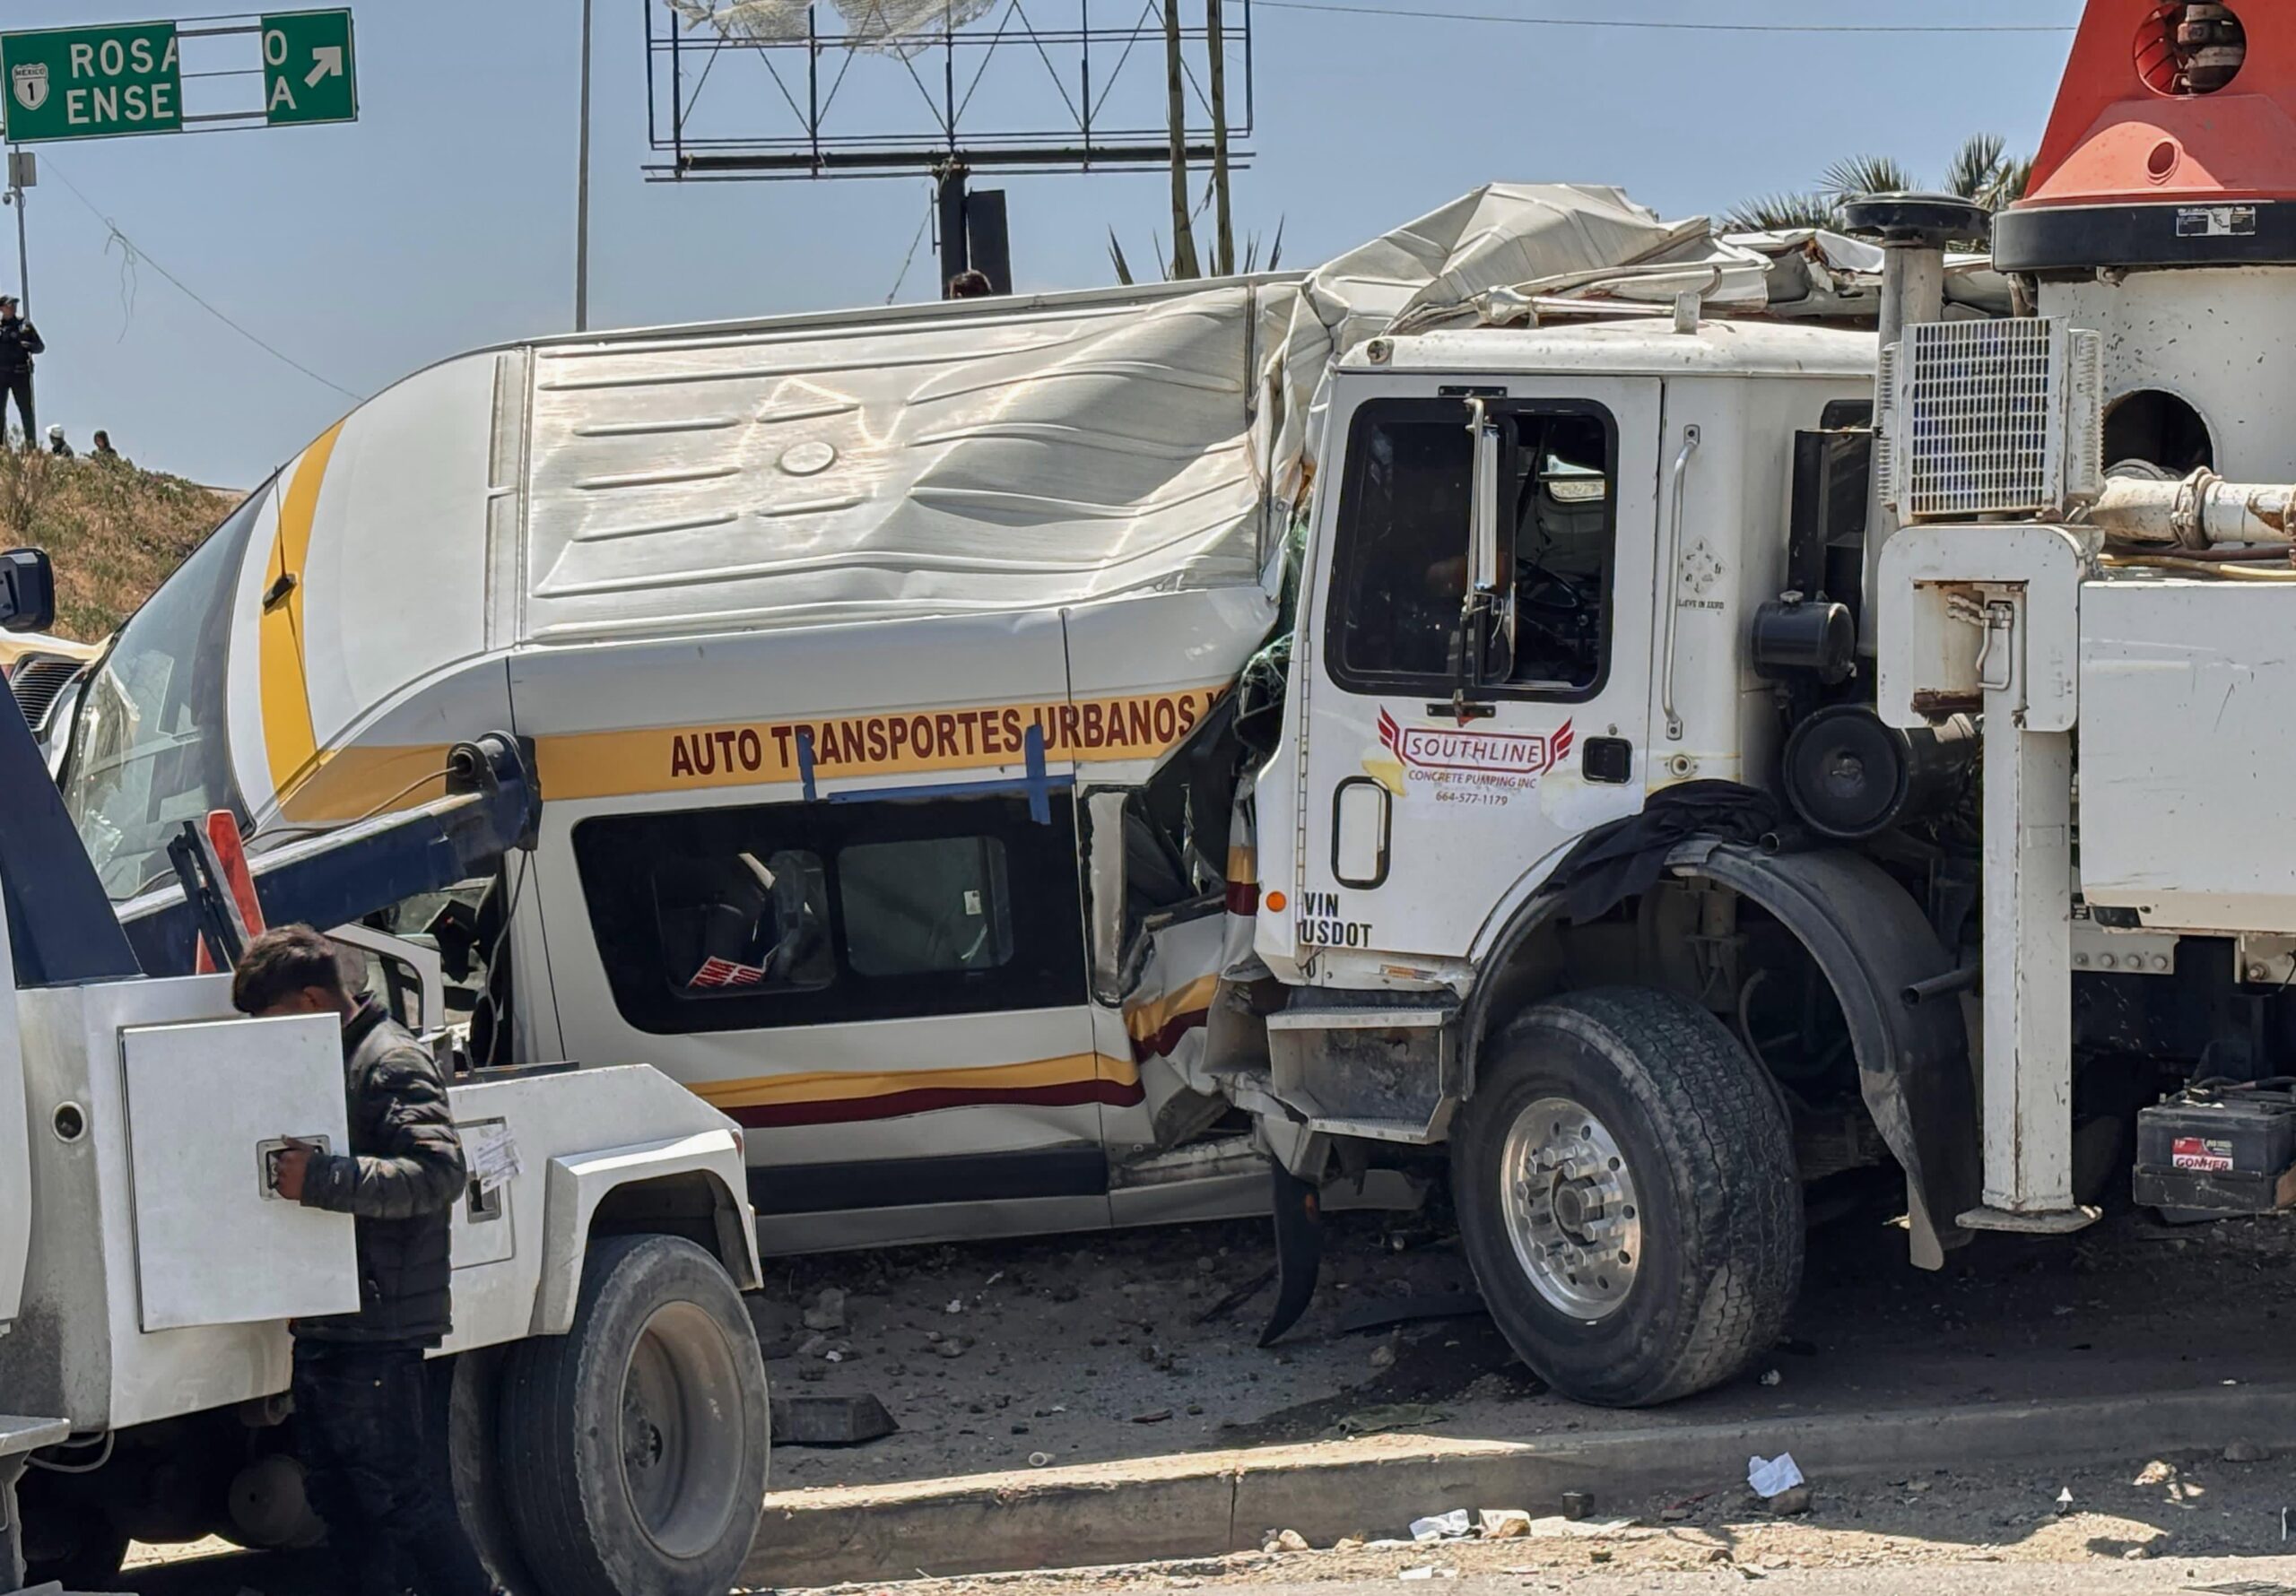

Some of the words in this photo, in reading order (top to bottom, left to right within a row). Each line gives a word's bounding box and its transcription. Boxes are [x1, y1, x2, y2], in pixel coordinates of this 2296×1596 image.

[27, 81, 35, 101] 1
[65, 82, 174, 125] ENSE
[672, 728, 761, 777] AUTO
[770, 708, 1023, 768] TRANSPORTES
[1032, 694, 1196, 750] URBANOS
[1410, 737, 1540, 763] SOUTHLINE
[1408, 770, 1463, 784] CONCRETE
[1465, 774, 1516, 787] PUMPING
[1518, 777, 1536, 789] INC
[1435, 790, 1509, 806] 664-577-1179
[1304, 891, 1339, 917] VIN
[1301, 919, 1373, 948] USDOT
[2176, 1157, 2229, 1170] GONHER
